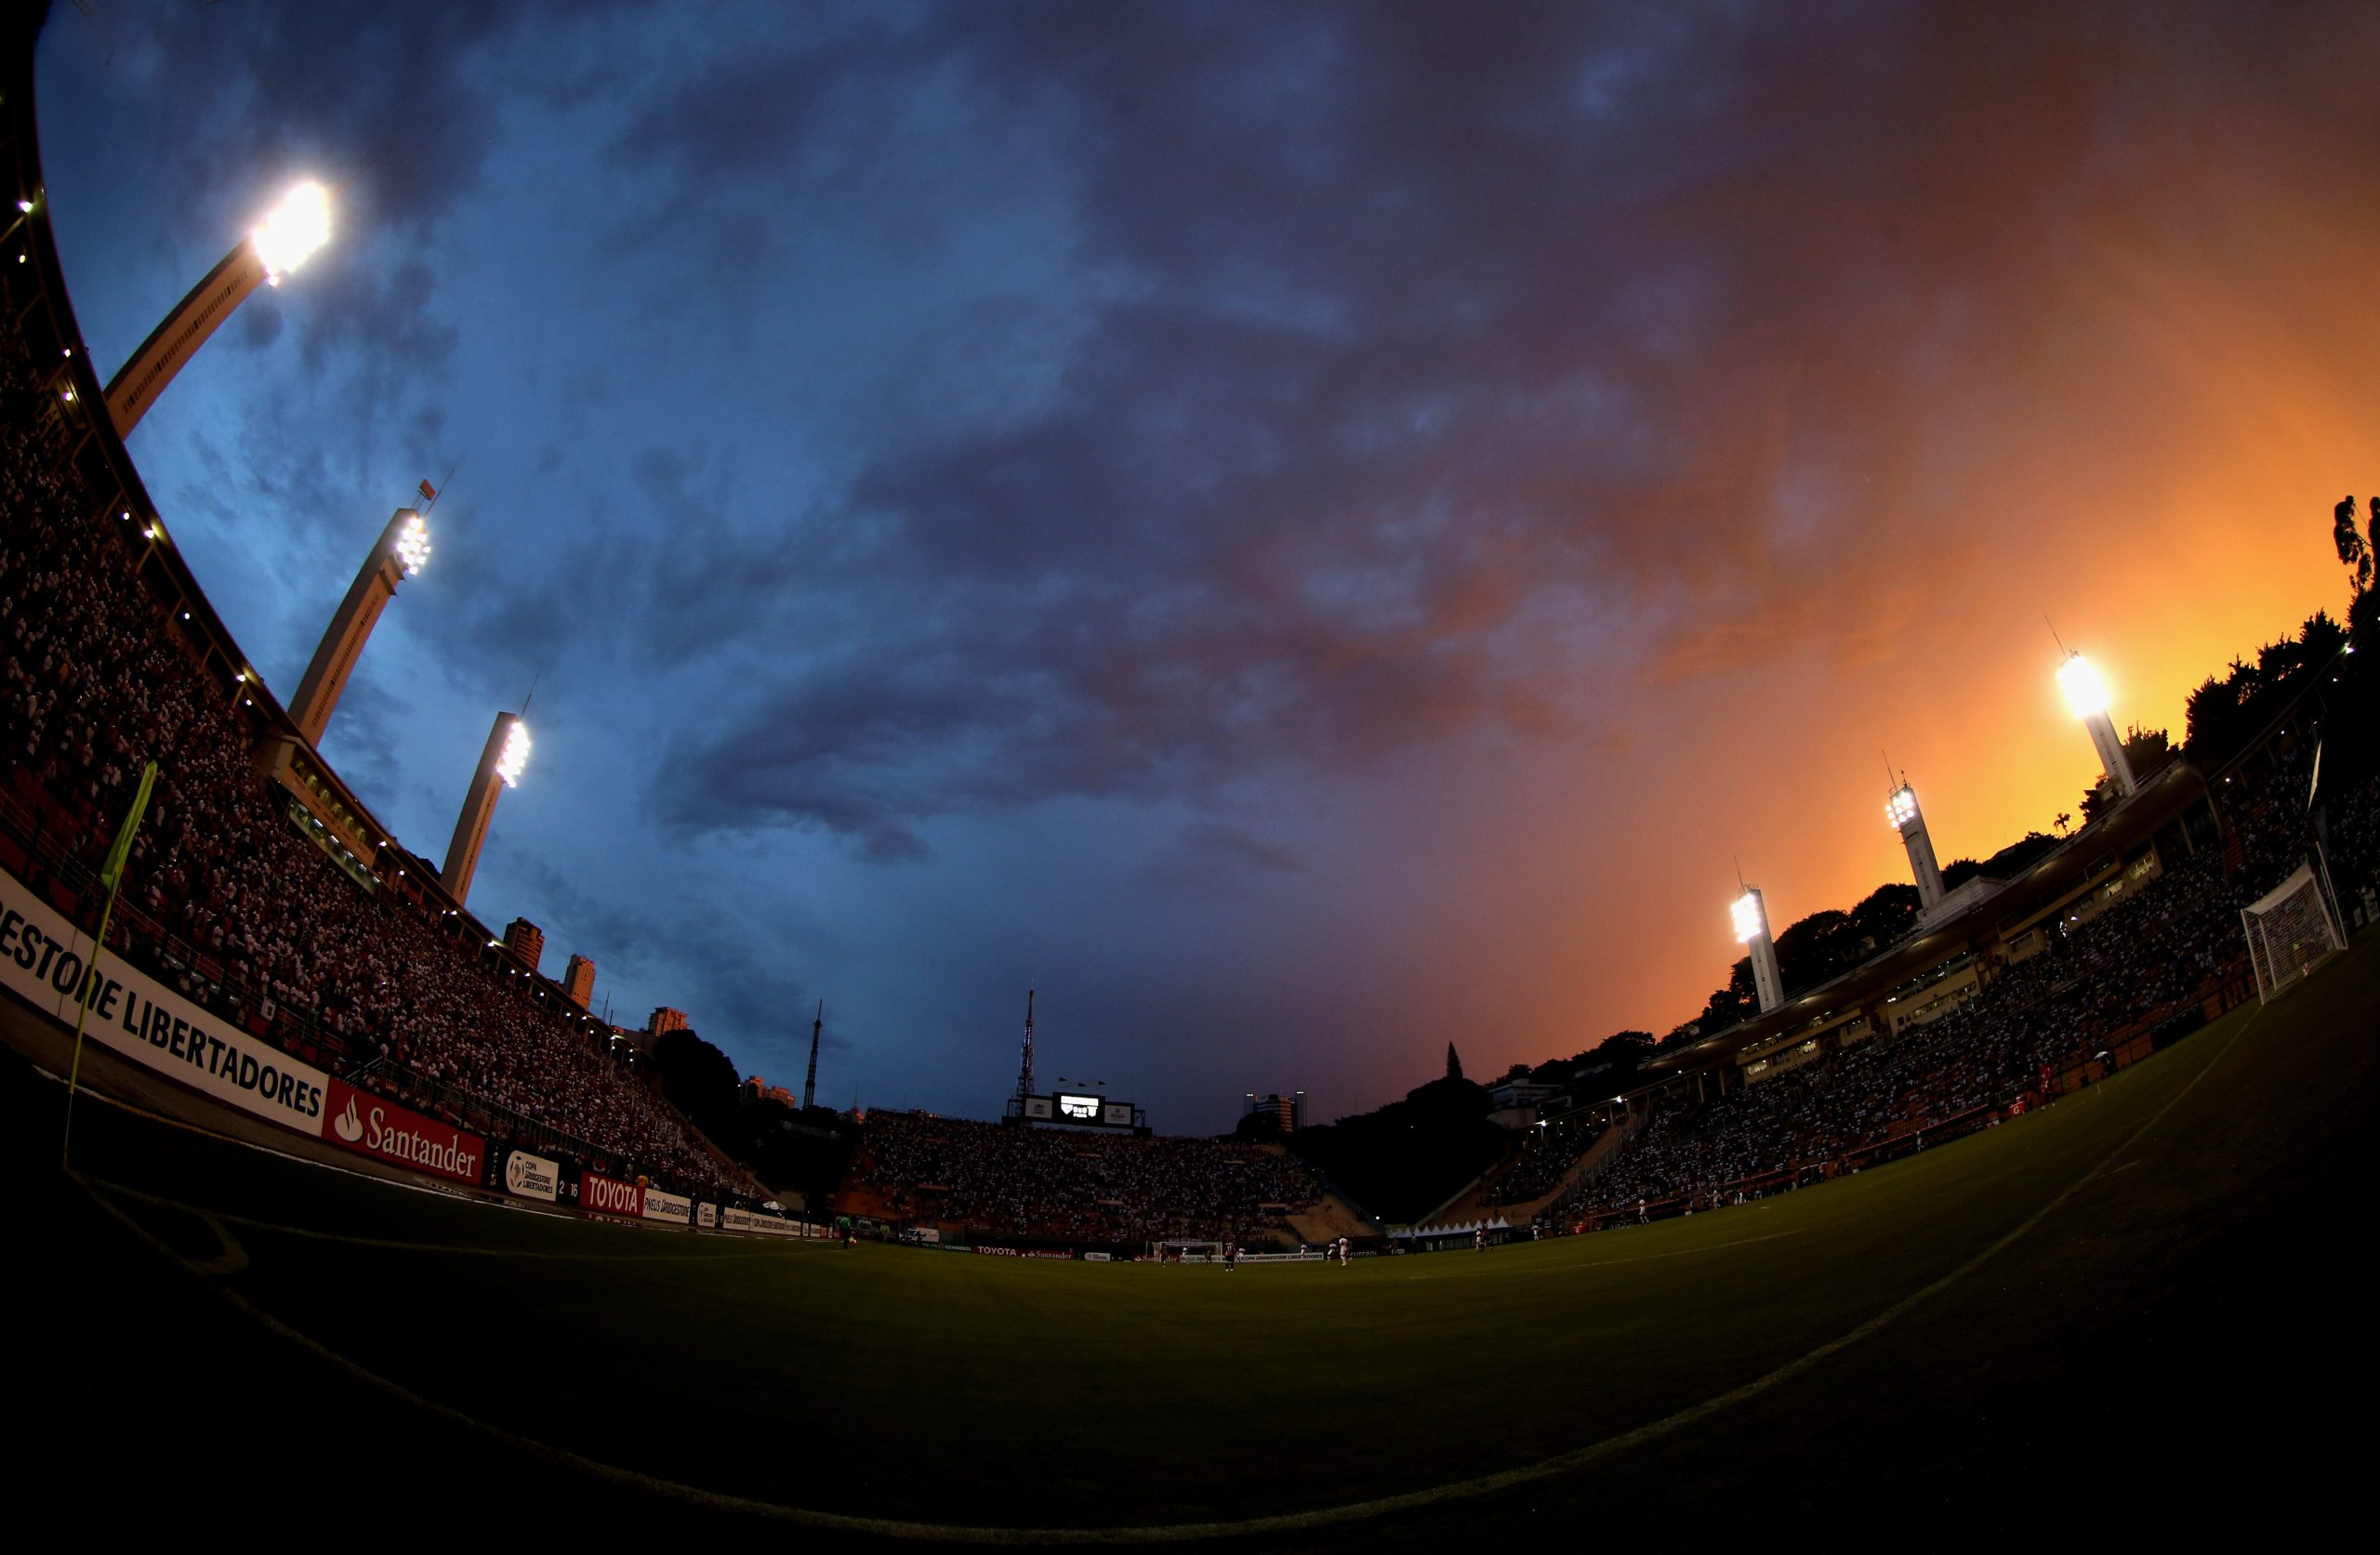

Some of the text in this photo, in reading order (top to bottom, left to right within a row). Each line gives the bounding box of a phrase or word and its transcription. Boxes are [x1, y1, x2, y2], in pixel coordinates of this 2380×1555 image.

[0, 898, 322, 1117] ESTONE LIBERTADORES
[366, 1106, 476, 1178] Santander
[524, 1161, 537, 1171] COPA
[522, 1179, 553, 1193] LIBERTADORES
[588, 1176, 638, 1213] TOYOTA
[644, 1197, 661, 1212] PNEUS
[977, 1245, 1017, 1257] TOYOTA
[1036, 1250, 1072, 1260] Santander
